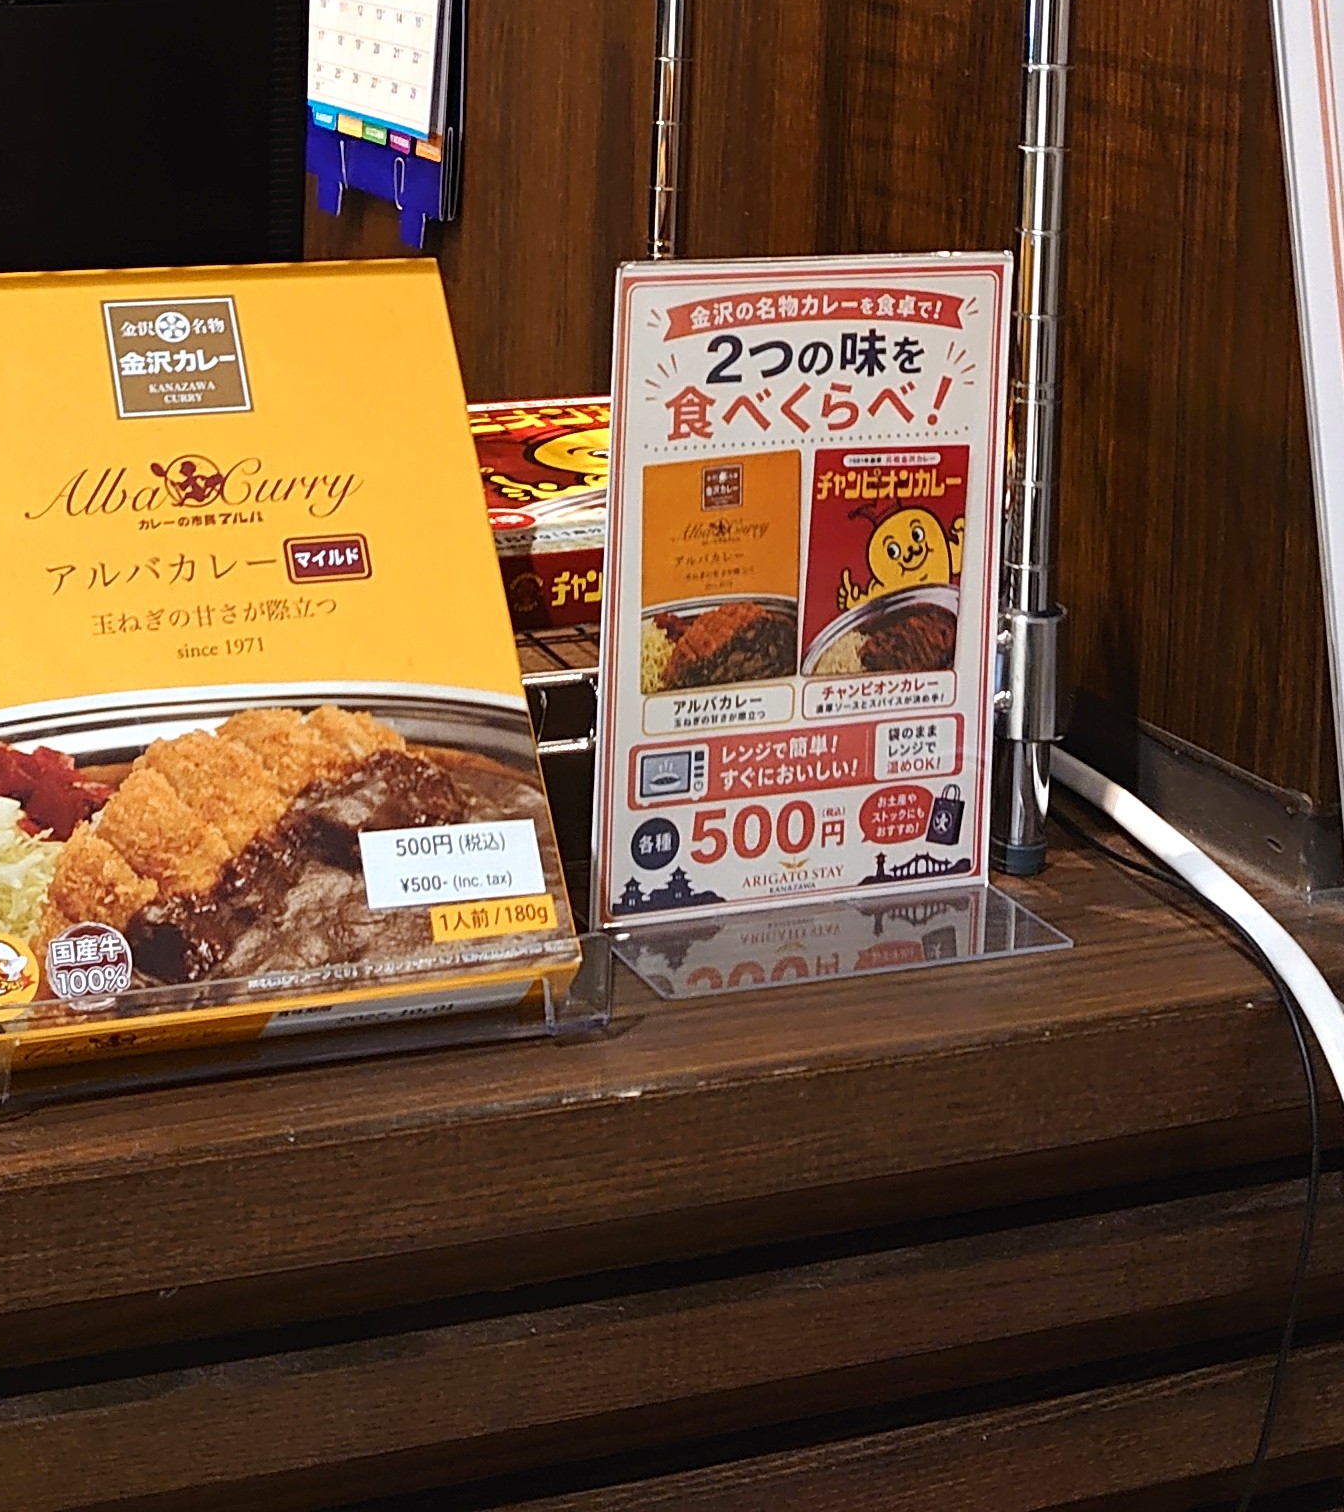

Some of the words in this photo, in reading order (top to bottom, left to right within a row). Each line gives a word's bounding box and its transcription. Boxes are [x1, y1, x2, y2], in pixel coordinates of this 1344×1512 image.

[690, 292, 942, 331] 金沢の名物カレーを食卓で!
[121, 321, 156, 338] 金沢
[192, 318, 225, 334] 名物
[119, 349, 236, 375] 金沢カレー
[706, 328, 925, 384] 2つの味を
[148, 381, 216, 393] KANAZAWA
[164, 393, 203, 404] CURRY
[665, 375, 953, 441] 食べくらべ!
[24, 467, 169, 519] Alba
[220, 457, 364, 518] Curry
[817, 468, 962, 500] チャンピオンカレー
[294, 547, 360, 569] マイルド
[45, 552, 277, 596] アルバカレー
[91, 596, 337, 637] 玉ねぎの甘さが際立つ
[177, 643, 219, 659] since
[225, 636, 264, 654] 1971
[821, 678, 939, 701] チャンピオンカレー
[673, 696, 763, 715] アルバカレー
[888, 724, 937, 741] 袋のまま
[721, 735, 838, 763] レンジで簡単!
[889, 742, 937, 758] レンジで
[720, 758, 858, 788] すぐにおいしい!
[872, 807, 925, 824] ストックにも
[395, 834, 452, 857] 500円
[458, 832, 506, 853] (税込)
[638, 832, 671, 856] 各種
[690, 800, 815, 864] 500
[821, 819, 845, 848] 円
[400, 876, 448, 893] ¥500-
[452, 876, 483, 892] (Inc.
[487, 870, 512, 888] tax)
[742, 871, 809, 889] ARIGATO
[812, 865, 844, 880] STAY
[769, 882, 816, 894] KANAZAWA
[51, 935, 125, 967] 国産牛
[56, 965, 130, 997] 100%
